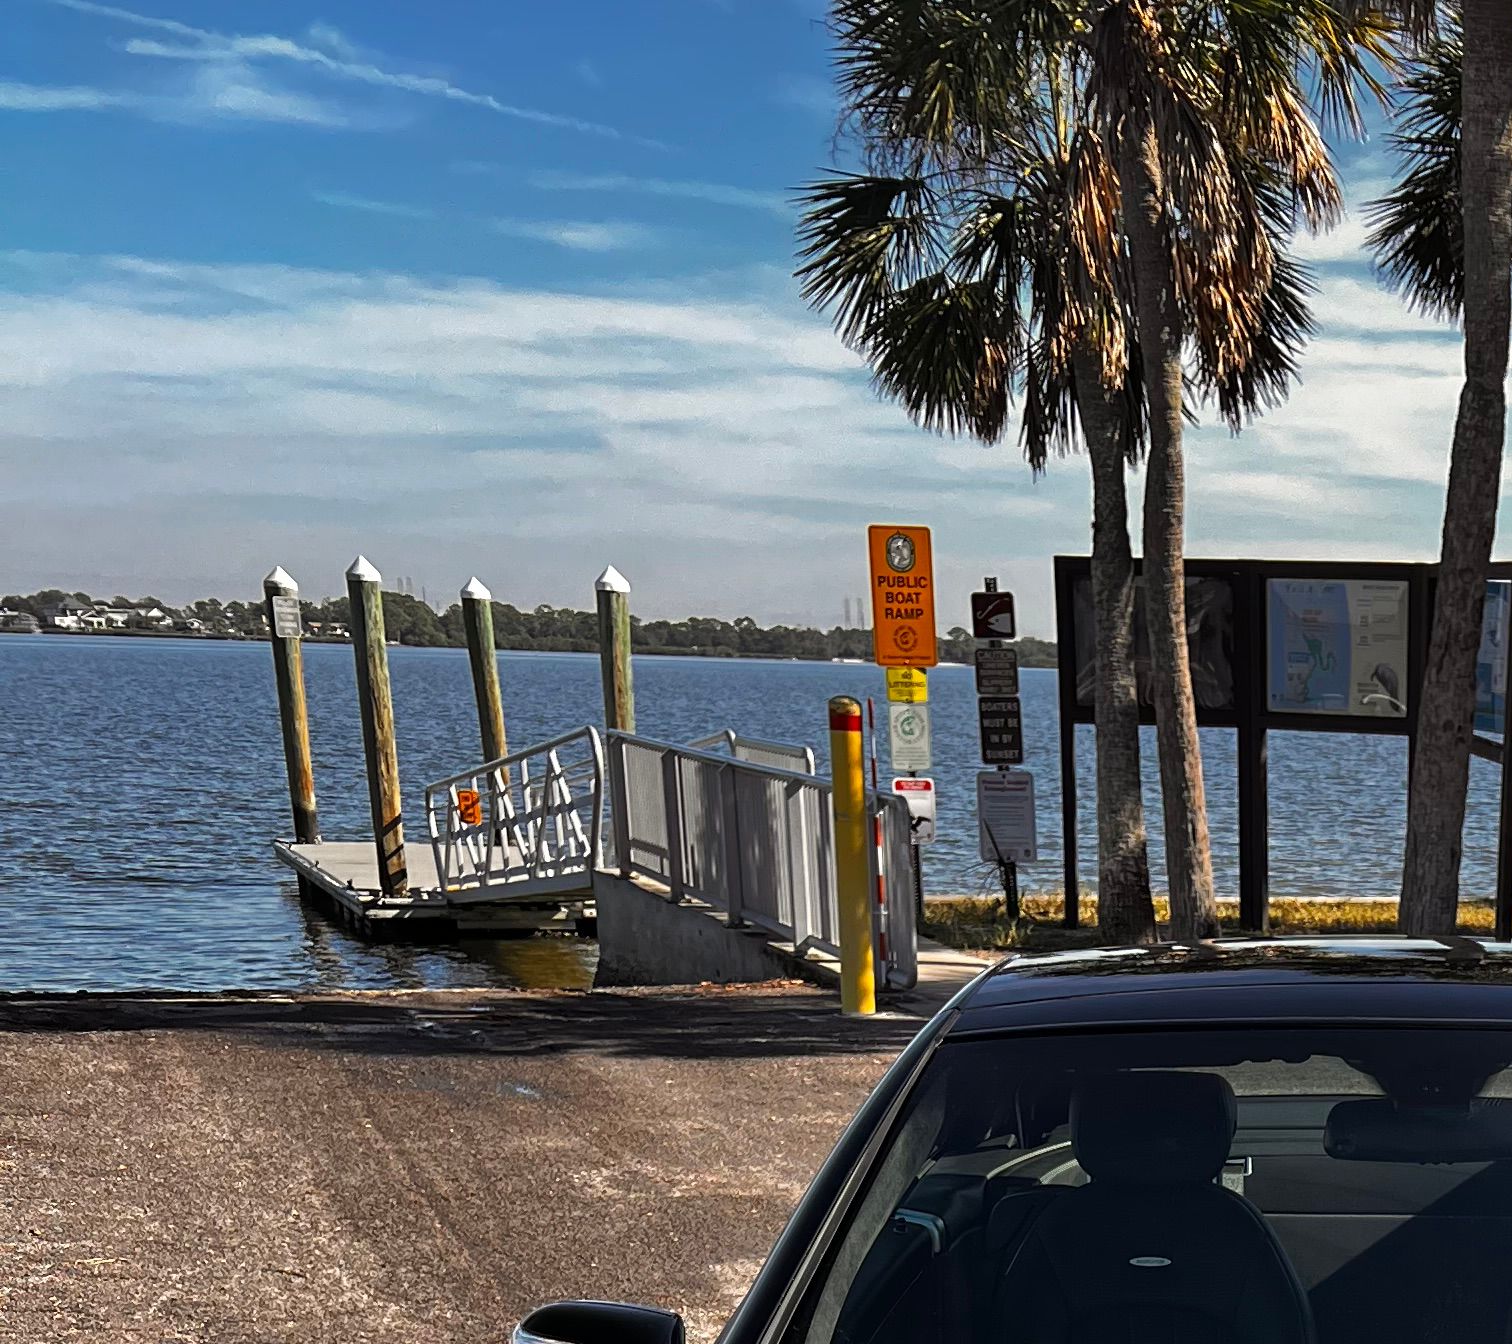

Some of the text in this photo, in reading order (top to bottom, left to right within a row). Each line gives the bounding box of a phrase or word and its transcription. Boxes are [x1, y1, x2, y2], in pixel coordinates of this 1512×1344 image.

[877, 575, 928, 589] PUBLIC
[885, 591, 922, 604] BOAT
[885, 607, 924, 620] RAMP
